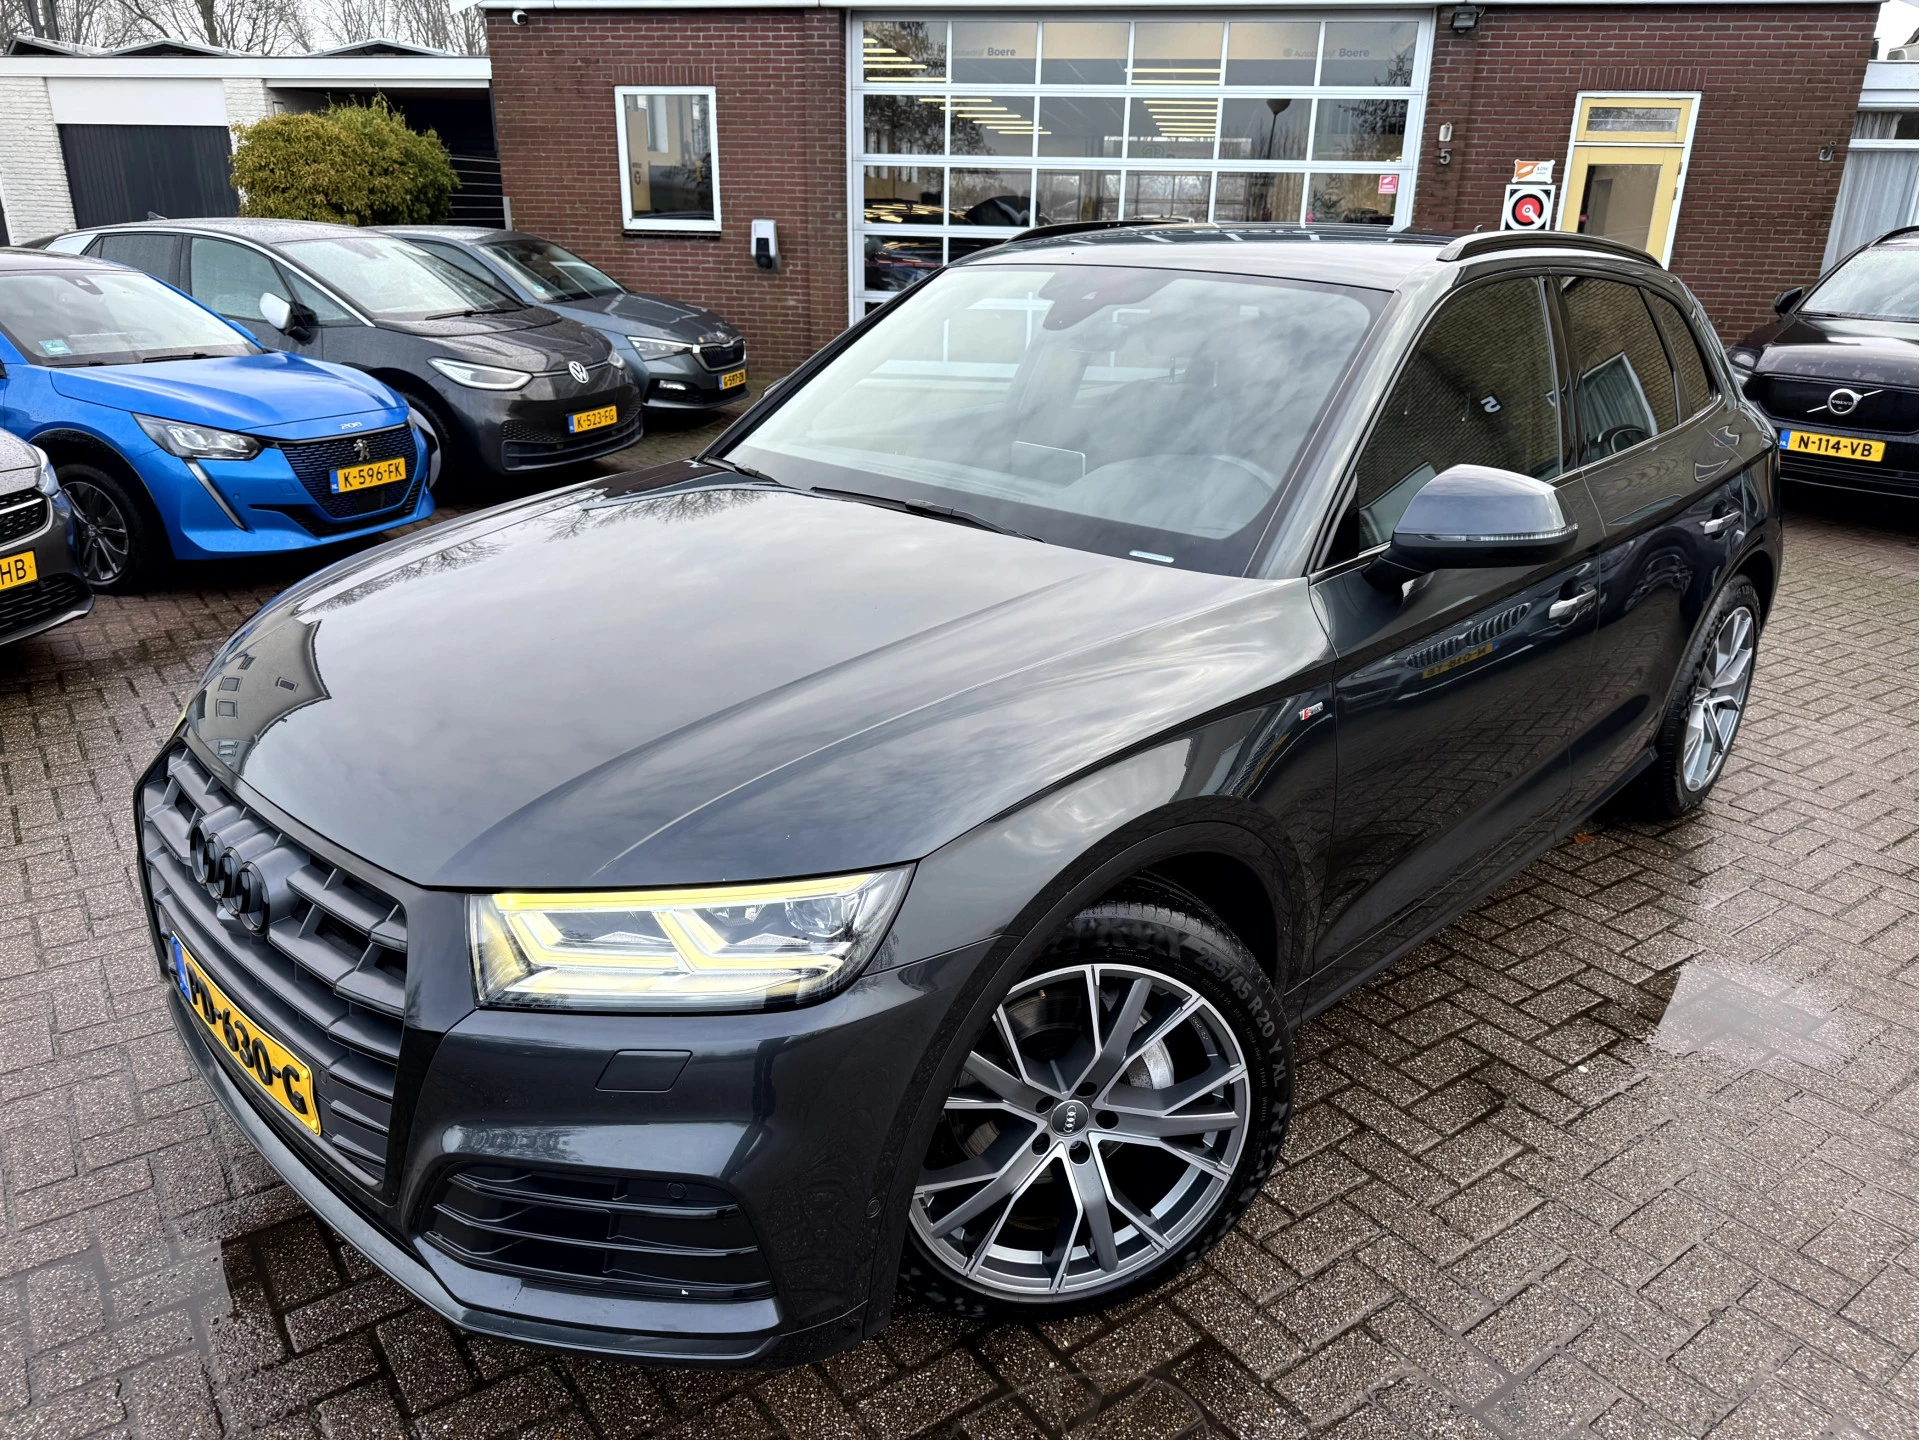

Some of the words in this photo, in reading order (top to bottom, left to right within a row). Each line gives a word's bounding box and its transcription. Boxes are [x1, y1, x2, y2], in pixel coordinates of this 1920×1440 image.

[987, 47, 1017, 57] Boere
[1339, 48, 1370, 58] Boere
[1439, 148, 1451, 165] 5
[576, 408, 614, 430] K-523-FG
[1797, 434, 1873, 458] N-114-VB
[343, 461, 402, 489] K-596-FK
[1194, 946, 1253, 1000] 255/45
[1268, 1037, 1283, 1055] Y
[1271, 1057, 1287, 1088] XL
